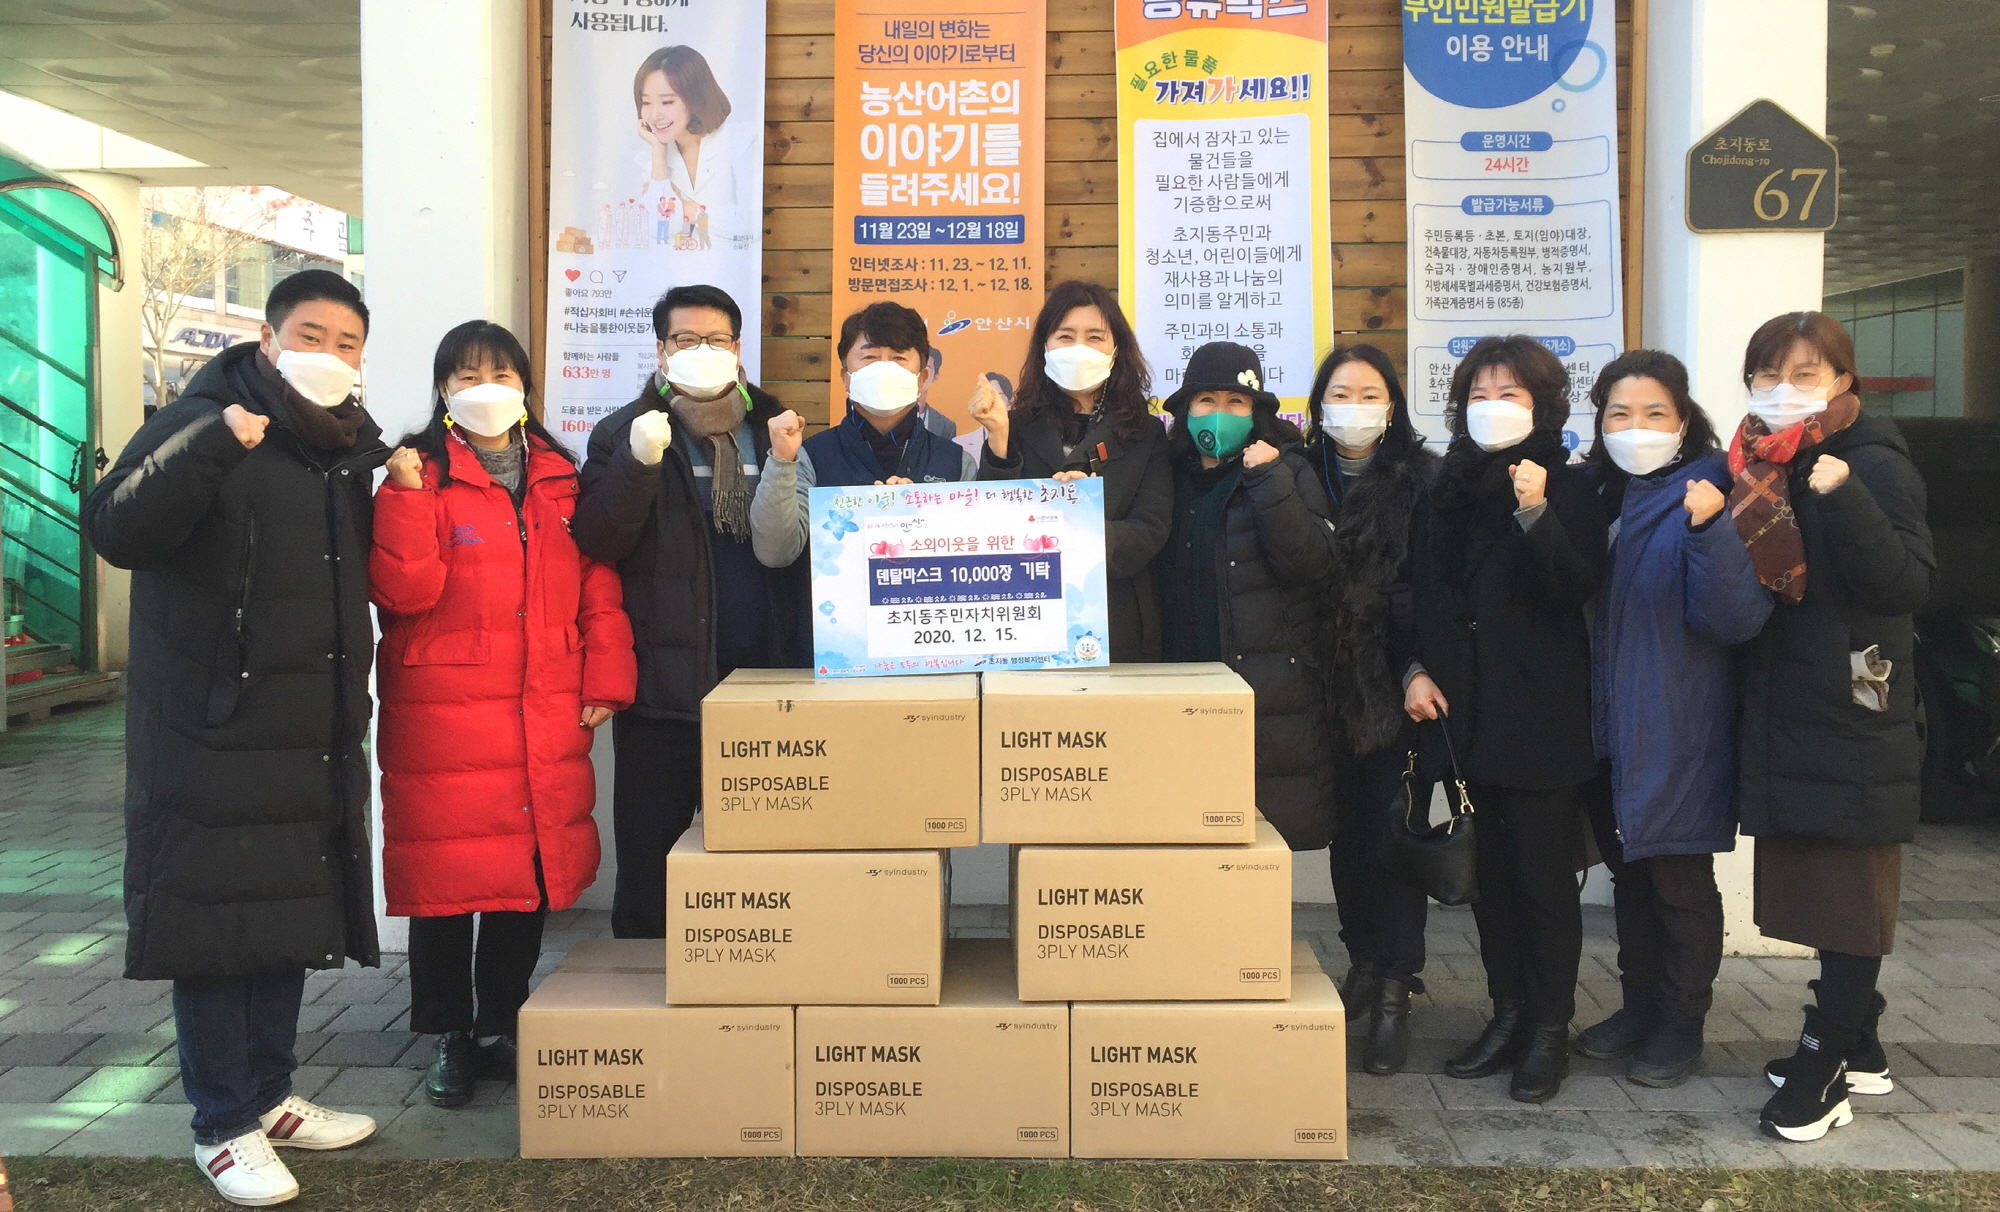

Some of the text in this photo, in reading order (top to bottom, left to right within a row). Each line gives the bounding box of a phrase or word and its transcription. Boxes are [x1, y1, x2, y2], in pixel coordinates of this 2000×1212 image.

[570, 12, 668, 32] 사용됩니다.
[884, 19, 990, 39] 내일의 변화는
[858, 43, 1015, 63] 당신의 이야기로부터
[1446, 34, 1548, 62] 이용 안내
[1130, 49, 1218, 92] 필요한 물품
[1155, 73, 1309, 104] 가져가세요!!
[860, 79, 1019, 116] 농산어촌의
[860, 122, 1022, 167] 이야기를
[1153, 127, 1290, 148] 집에서 잠자고 있는
[1482, 134, 1531, 148] 운영시간
[1714, 137, 1771, 152] 초지동로
[1188, 151, 1253, 170] 물건들을
[1485, 156, 1529, 173] 24시간
[1701, 154, 1770, 166] Chojidong-ro
[859, 172, 1021, 206] 들려주세요!
[1155, 170, 1289, 192] 필요한 사람들에게
[1753, 168, 1828, 221] 67
[1173, 193, 1271, 213] 기증함으로써
[1471, 197, 1545, 212] 발급가능서류
[860, 222, 893, 240] 11월
[897, 222, 931, 239] 23일
[986, 221, 1019, 238] 18일
[1172, 224, 1272, 243] 초지동주민과
[1424, 227, 1591, 242] 주민등록등 초본, 토지(임야)대장,
[1145, 244, 1302, 266] 청소년, 어린이들에게
[1425, 243, 1591, 259] 건축물대장, 자동차등록원부, 병적증명서,
[849, 256, 1032, 272] 인터넷조사 11. 23. 12. 11.
[1424, 260, 1592, 275] 수급자 장애인증명서, 농지원부,
[848, 277, 1033, 293] 방문면접조사 12. 1. 12. 18.
[1164, 268, 1282, 288] 재사용과 나눔의
[1425, 277, 1592, 293] 지방세세목별과세증명서, 건강보험증명서,
[1164, 291, 1282, 310] 의미를 알게하고
[1425, 296, 1523, 309] 가족관계증명서 등 (85종)
[564, 307, 617, 318] #적십자회비
[974, 316, 1030, 331] 안산시
[1164, 321, 1283, 340] 주민과의 소통과
[563, 351, 620, 361] 함께하는 사람들
[562, 365, 611, 378] 633만 명
[561, 405, 602, 415] 도움을 받은
[868, 491, 895, 510] 이웃!
[905, 490, 942, 509] 소통하는
[949, 487, 978, 507] 마을!
[985, 490, 996, 500] 더
[1001, 486, 1033, 503] 행복한
[1040, 483, 1079, 505] 초지동
[909, 535, 1015, 552] 소외이웃을 위한
[876, 562, 1050, 586] 덴탈마스크 10,000장 기탁
[887, 605, 1041, 626] 초지동주민자치위원회
[914, 628, 1017, 644] 2020. 12. 15.
[988, 657, 1008, 665] 초지동
[921, 714, 966, 722] syindustry
[1001, 731, 1107, 748] LIGHT MASK
[721, 739, 827, 758] LIGHT MASK
[1001, 767, 1108, 782] DISPOSABLE
[721, 776, 829, 791] DISPOSABLE
[1000, 787, 1092, 801] 3PLY MASK
[721, 796, 813, 811] 3PLY MASK
[927, 821, 964, 829] 1000 PCS
[1205, 815, 1241, 823] 1000 PCS
[884, 868, 928, 876] syindustry
[1236, 863, 1280, 871] syindustry
[685, 892, 791, 909] LIGHT MASK
[1038, 888, 1144, 905] LIGHT MASK
[685, 929, 792, 943] DISPOSABLE
[1038, 924, 1145, 939] DISPOSABLE
[684, 948, 776, 962] 3PLY MASK
[1037, 943, 1129, 959] 3PLY MASK
[736, 1023, 781, 1031] syindustry
[1013, 1022, 1058, 1030] syindustry
[1290, 1023, 1335, 1031] syindustry
[538, 1048, 644, 1066] LIGHT MASK
[815, 1045, 921, 1063] LIGHT MASK
[1091, 1046, 1197, 1064] LIGHT MASK
[538, 1084, 645, 1099] DISPOSABLE
[816, 1082, 922, 1096] DISPOSABLE
[1091, 1082, 1199, 1097] DISPOSABLE
[537, 1104, 629, 1119] 3PLY MASK
[815, 1101, 906, 1116] 3PLY MASK
[1090, 1102, 1182, 1117] 3PLY MASK
[1296, 1132, 1333, 1140] 1000 PCS
